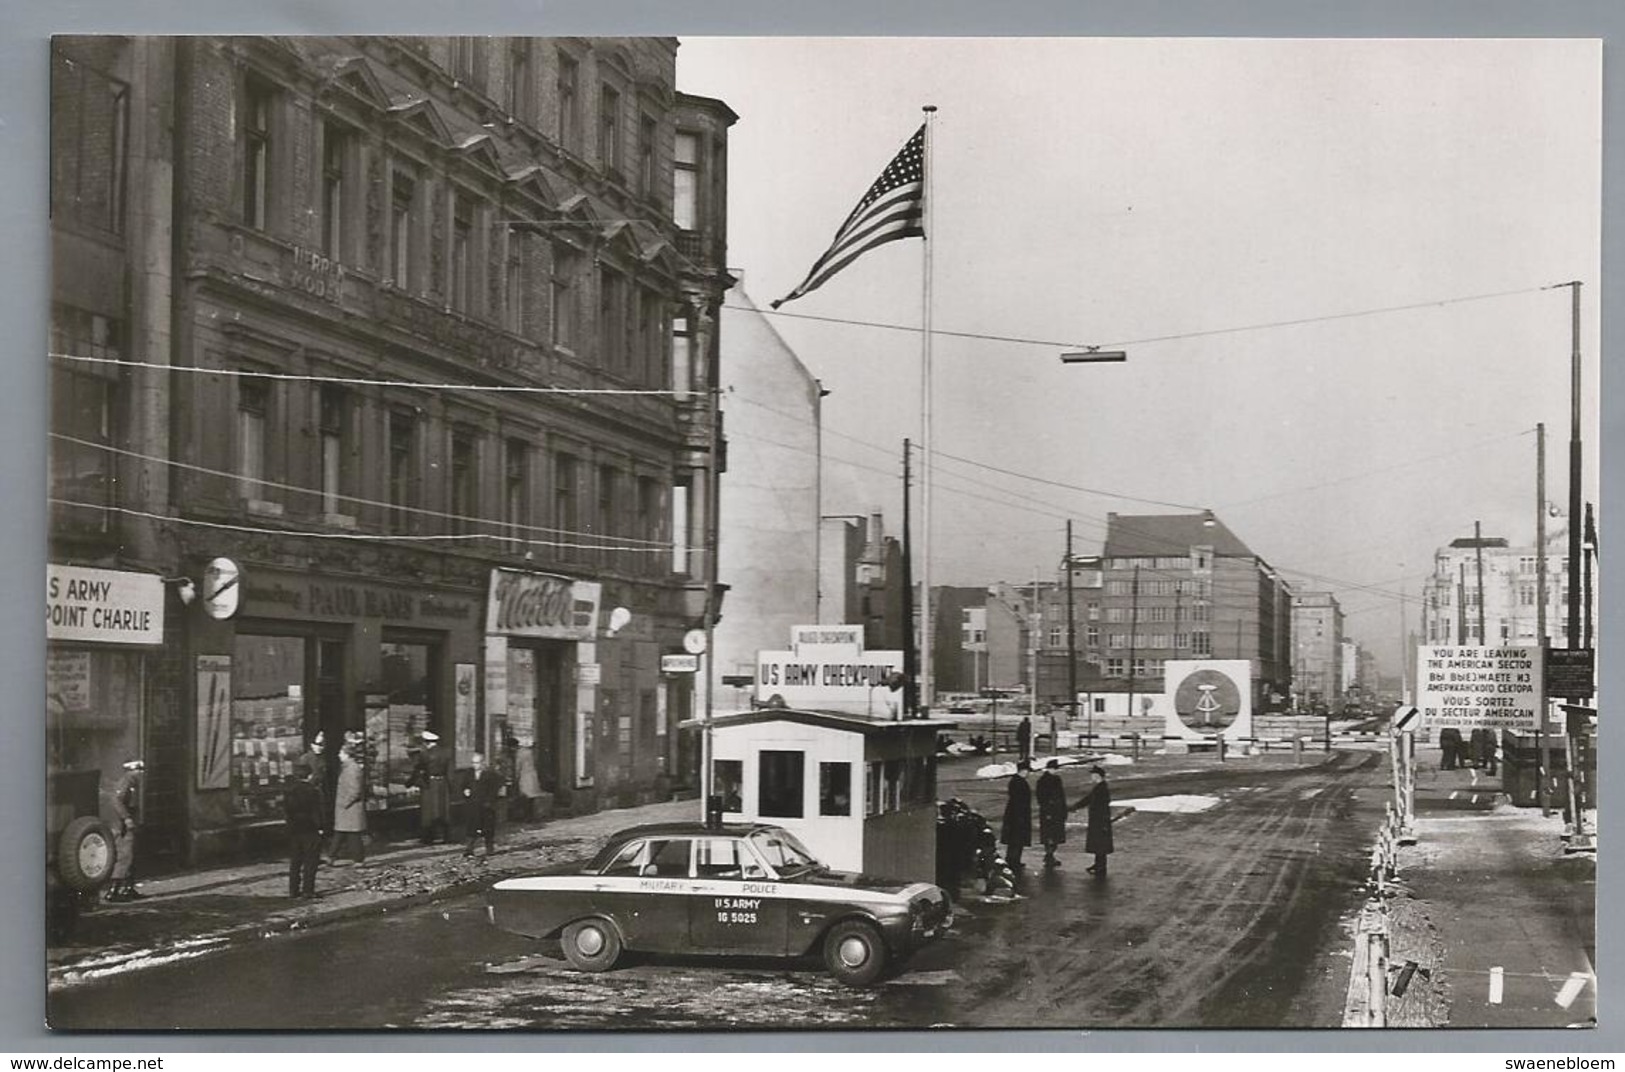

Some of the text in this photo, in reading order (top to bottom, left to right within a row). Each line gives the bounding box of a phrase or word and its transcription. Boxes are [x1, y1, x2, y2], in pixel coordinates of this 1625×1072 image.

[49, 577, 111, 602] S ARMY
[93, 608, 151, 631] CHARLIE
[1433, 649, 1528, 659] YOU ARE LEAVING
[1428, 659, 1533, 669] THE AMERICAN SECTOR
[784, 664, 818, 686] ARMY
[1429, 673, 1445, 682] ВЫ
[1517, 673, 1531, 683] ИЗ
[1427, 683, 1533, 694] АМЕРИКАНСКОГО СЕКТОРА
[1443, 697, 1515, 707] VOUS SORTEZ
[1425, 707, 1437, 716] DU
[1442, 708, 1480, 717] SECTEUR
[640, 882, 777, 894] MILITARY POLICE
[731, 913, 757, 923] 5025
